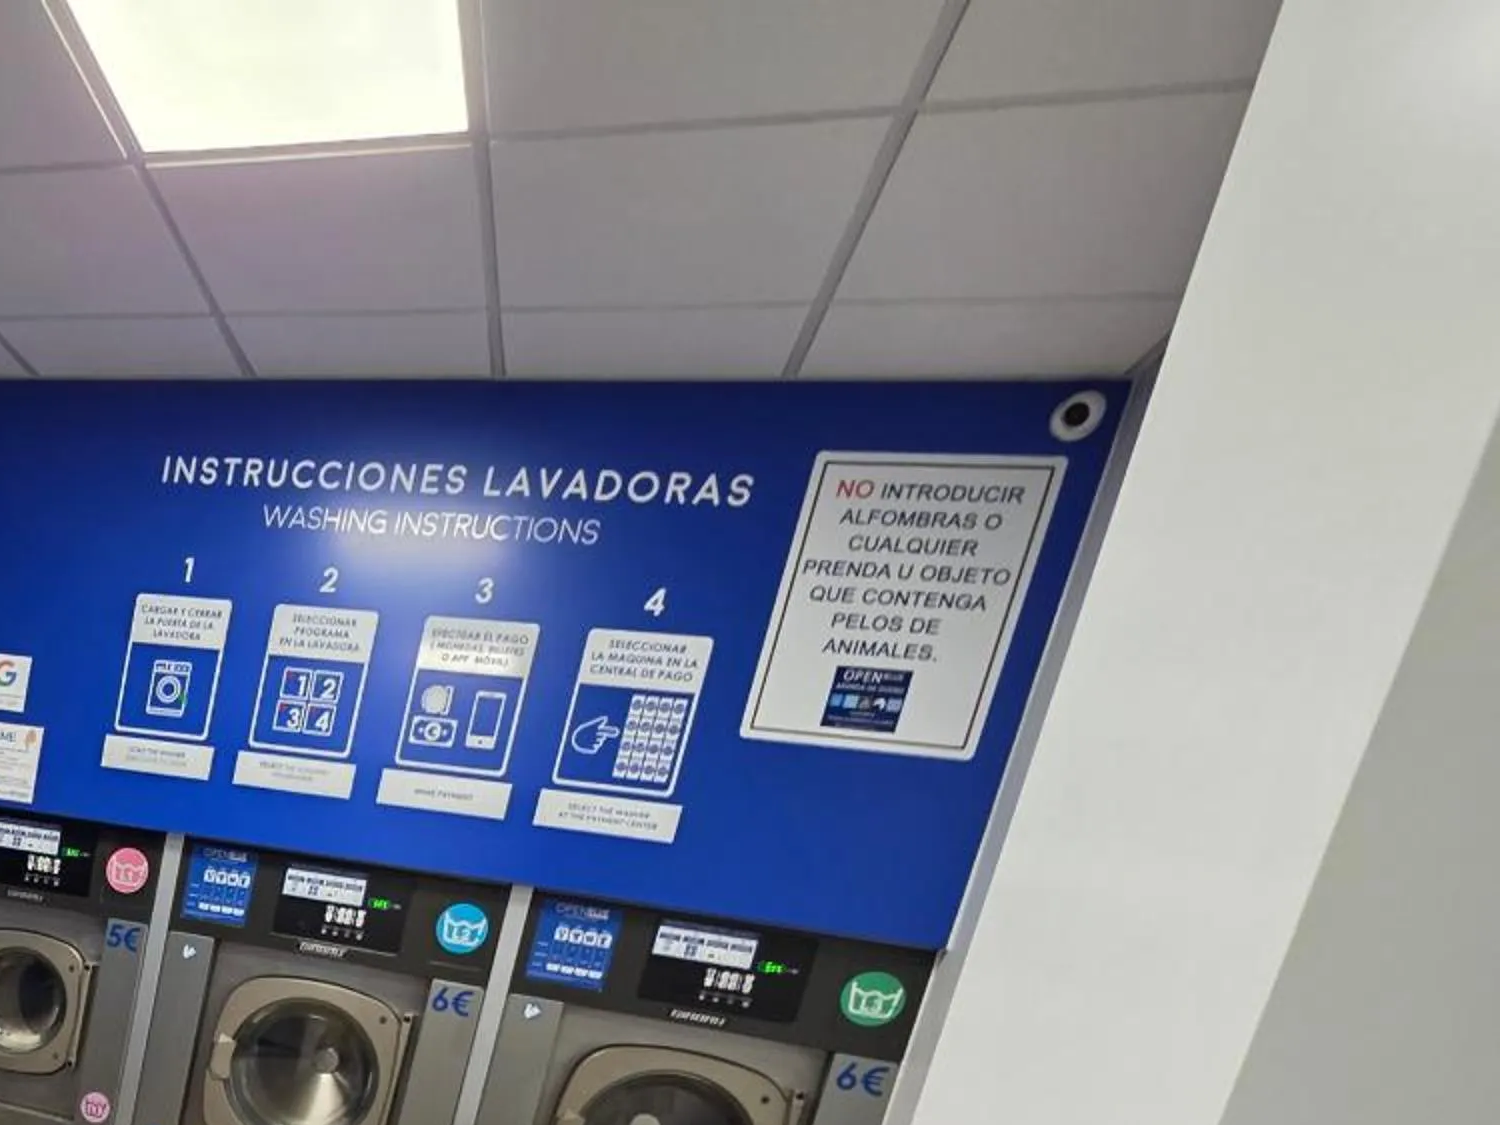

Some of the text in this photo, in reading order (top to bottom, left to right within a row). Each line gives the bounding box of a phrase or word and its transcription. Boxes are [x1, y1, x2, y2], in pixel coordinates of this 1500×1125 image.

[160, 455, 755, 507] INSTRUCCIONES LAVADORAS
[835, 479, 1026, 505] NO INTRODUCIR
[262, 504, 602, 546] WASHING INSTRUCTIONS
[838, 508, 1004, 531] ALFOMBRAS O
[847, 534, 980, 557] CUALQUIER
[182, 556, 196, 583] 1
[319, 566, 340, 593] 2
[801, 559, 1013, 587] PRENDA U OBJETO
[474, 577, 495, 605] 3
[643, 587, 668, 617] 4
[808, 584, 988, 613] QUE CONTENGA
[292, 612, 358, 628] SELECCIONAR
[293, 626, 350, 640] PROGRAMA
[829, 612, 943, 636] PELOS DE
[591, 650, 605, 662] LA
[666, 657, 682, 669] EN
[683, 658, 699, 669] LA
[608, 638, 688, 655] SELECCIONAR
[820, 636, 939, 663] ANIMALES.
[589, 663, 694, 683] CENTRAL DE PAGO
[106, 922, 142, 953] 5€
[431, 986, 475, 1018] 6€
[836, 1061, 891, 1097] 6€
